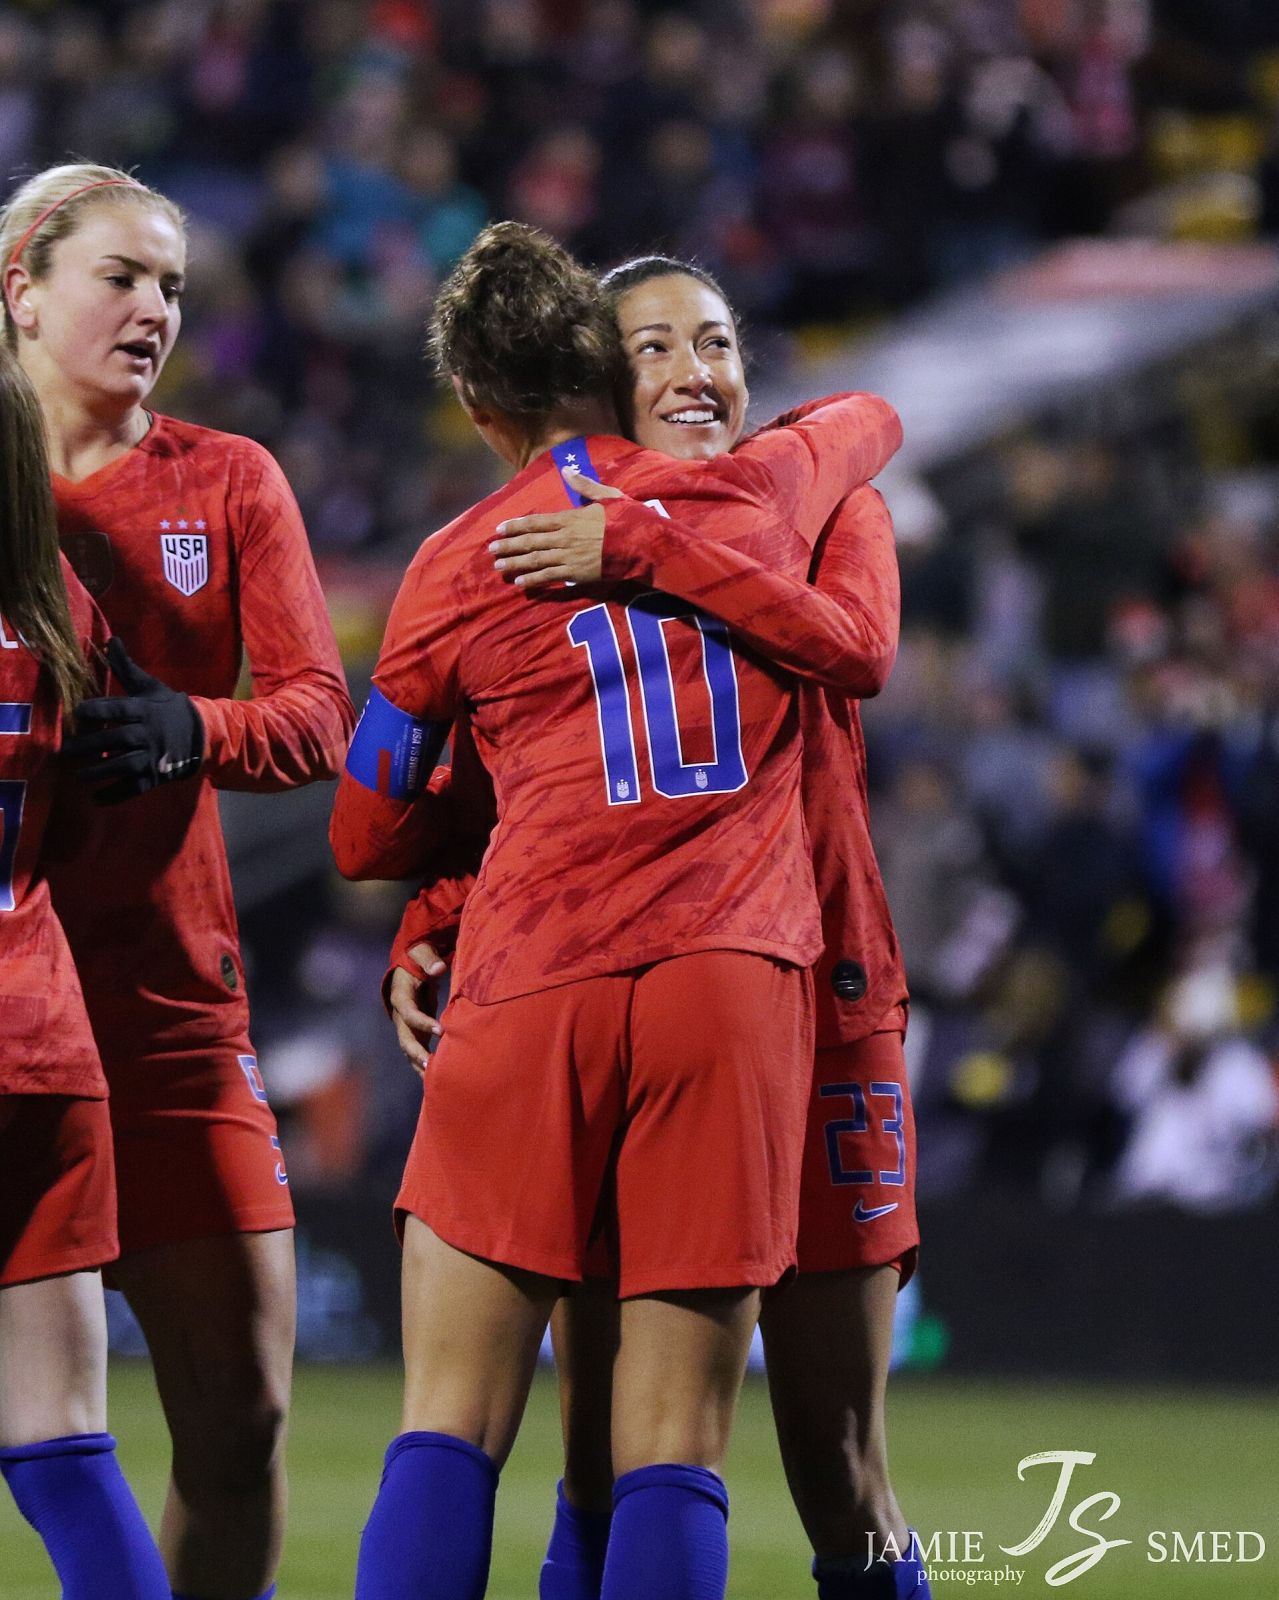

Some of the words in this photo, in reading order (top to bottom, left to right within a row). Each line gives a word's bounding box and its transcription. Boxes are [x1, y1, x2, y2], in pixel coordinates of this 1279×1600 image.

[165, 538, 203, 560] USA
[567, 591, 749, 806] 10
[818, 1081, 906, 1187] 23
